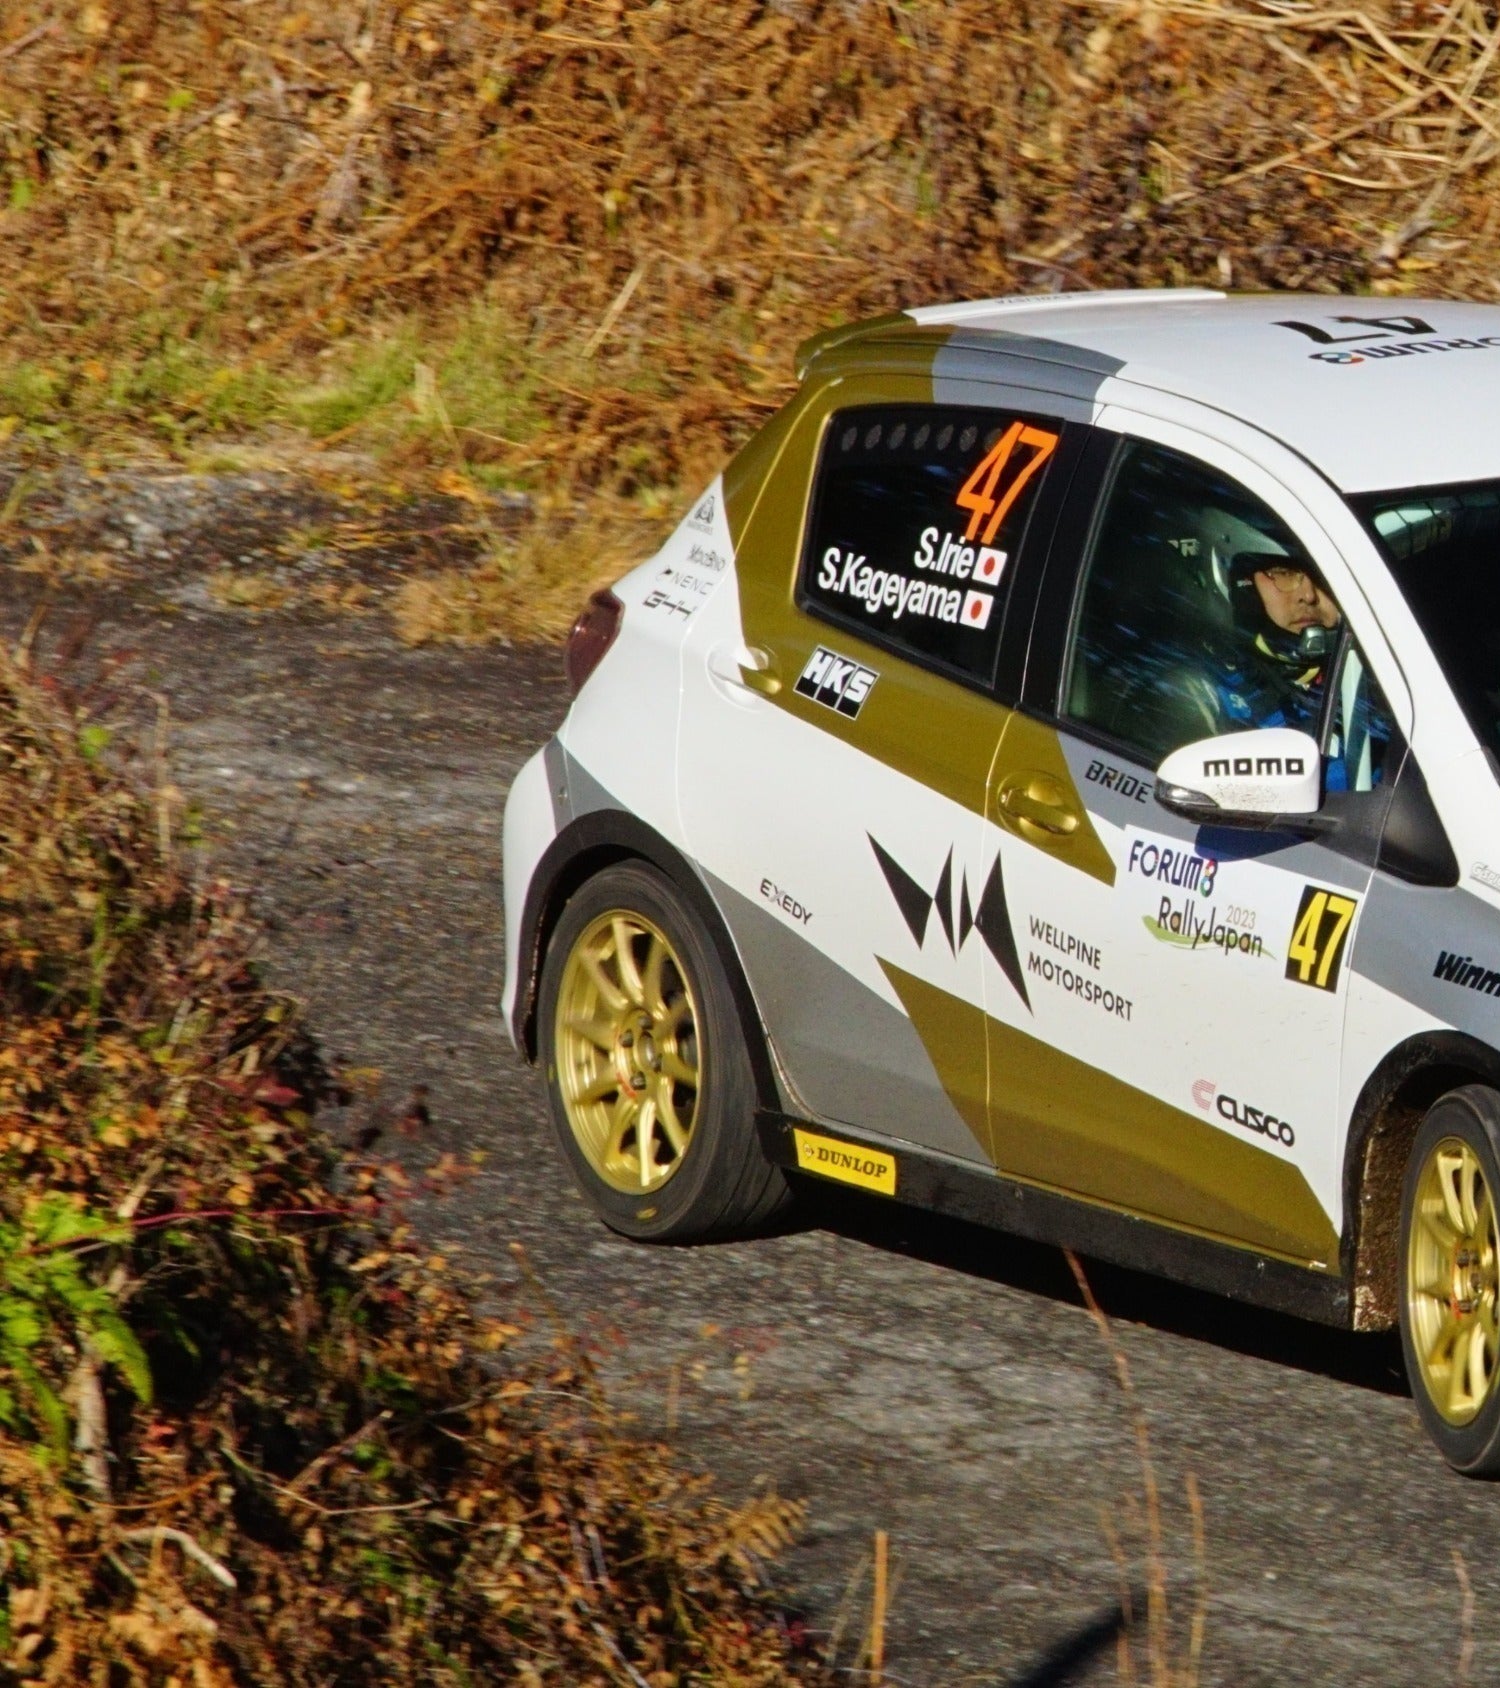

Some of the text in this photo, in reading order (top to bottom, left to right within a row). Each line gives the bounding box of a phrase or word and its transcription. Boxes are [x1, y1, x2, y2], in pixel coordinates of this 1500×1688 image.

[1270, 315, 1438, 344] 47
[956, 422, 1058, 544] 47
[914, 527, 975, 581] S.Irie
[818, 548, 962, 625] S.Kageyama
[799, 649, 878, 710] HKS
[1085, 760, 1154, 804] BRIDE
[1128, 840, 1219, 897] FORUM8
[759, 878, 813, 926] EXEDY
[1226, 905, 1256, 929] 2023
[1028, 915, 1101, 969] WELLPINE
[1288, 892, 1356, 988] 47
[1027, 952, 1133, 1021] MOTORSPORT
[817, 1145, 888, 1179] DUNLOP
